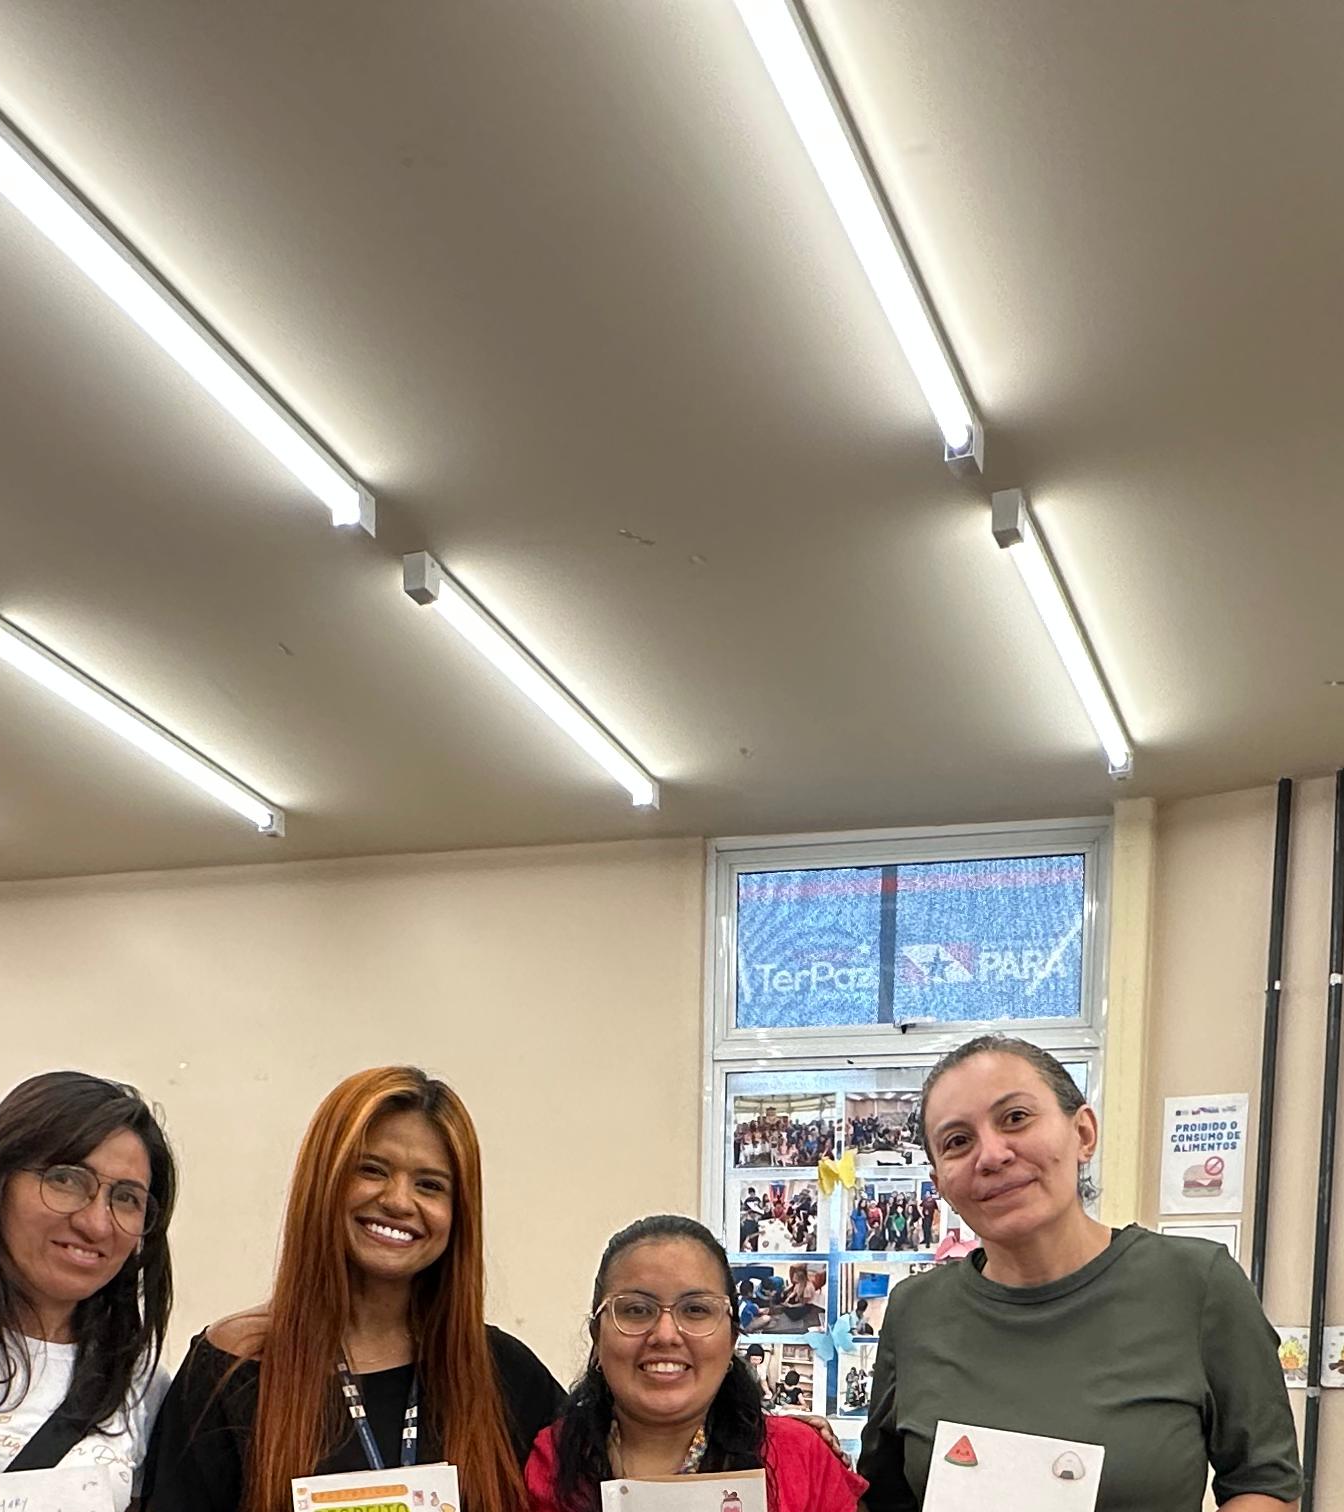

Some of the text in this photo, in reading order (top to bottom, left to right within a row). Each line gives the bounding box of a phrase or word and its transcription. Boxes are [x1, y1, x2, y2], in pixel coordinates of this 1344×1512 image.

[1175, 1120, 1238, 1133] PROIBIDO O
[1170, 1131, 1241, 1143] CONSUMO DE
[1173, 1141, 1237, 1153] ALIMENTOS
